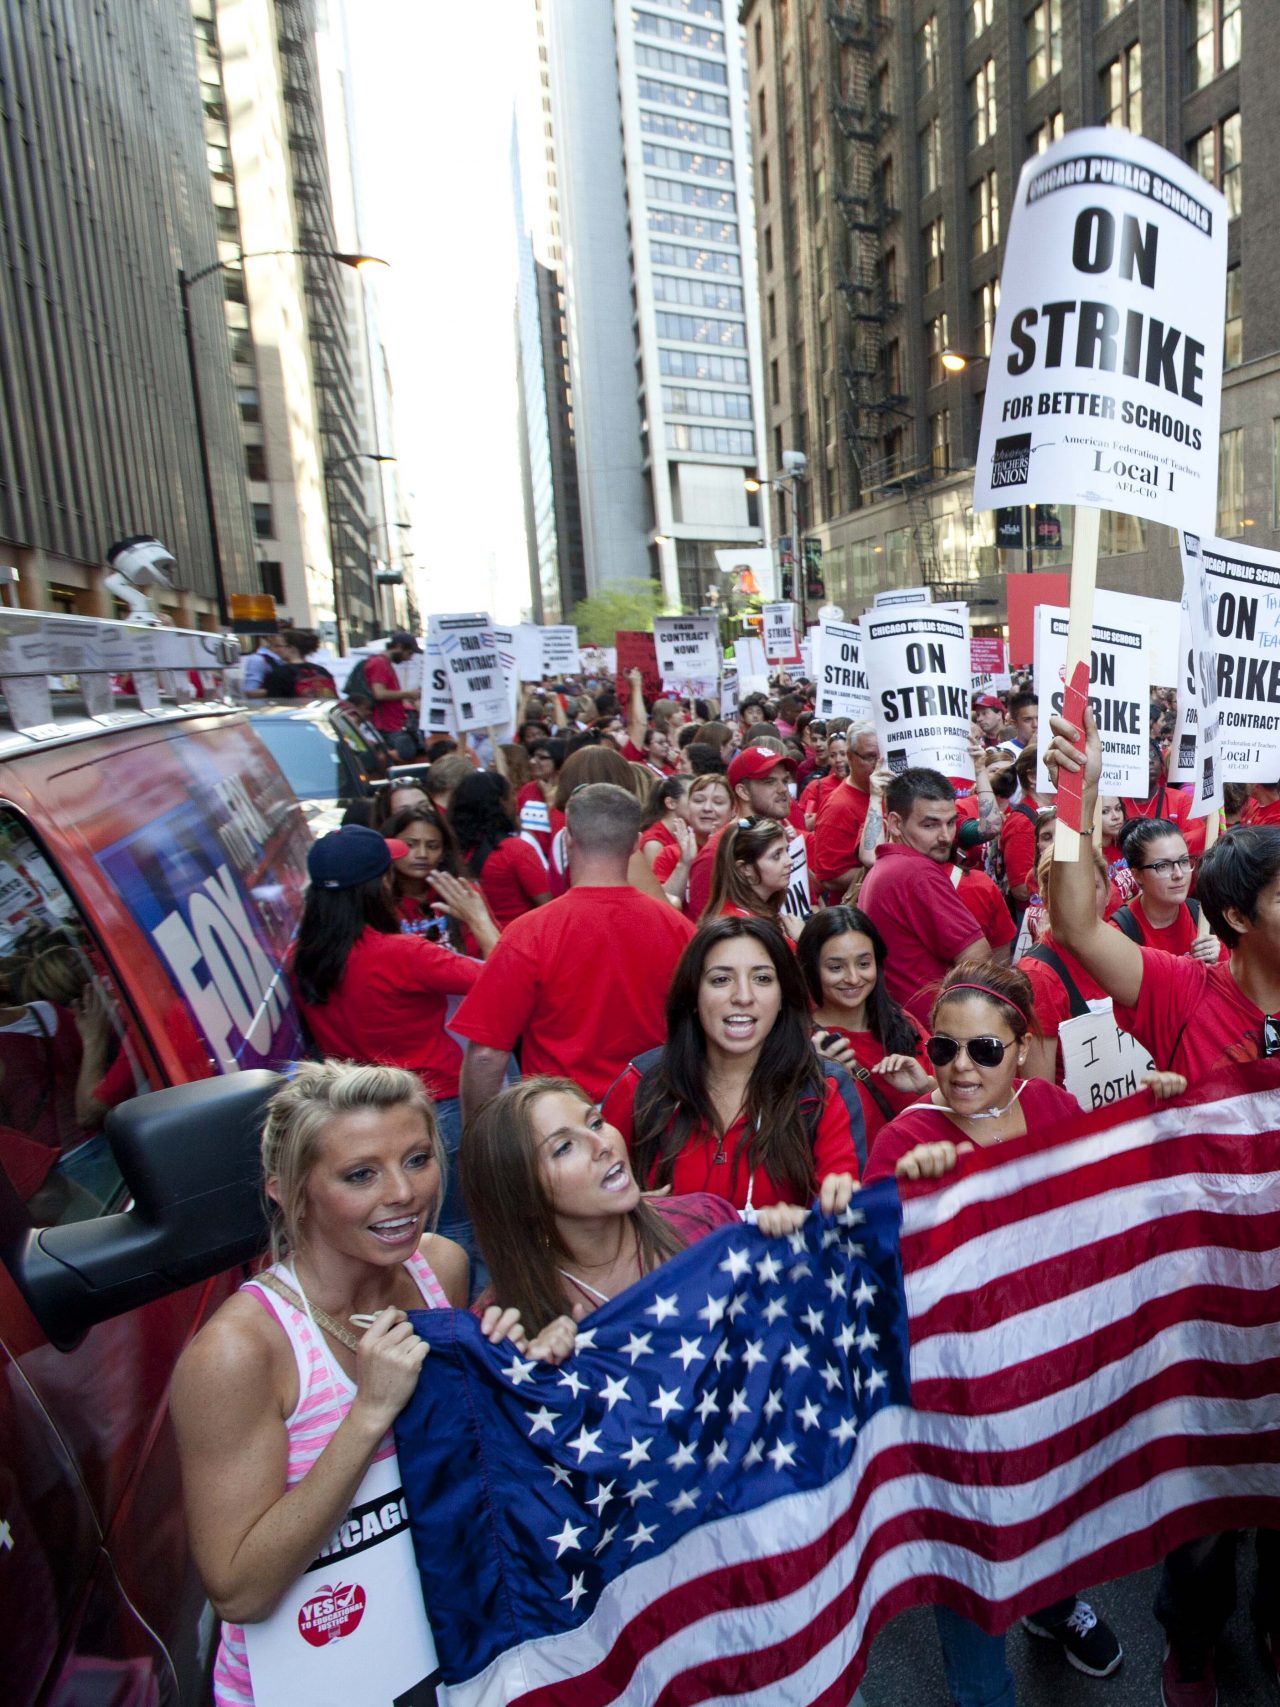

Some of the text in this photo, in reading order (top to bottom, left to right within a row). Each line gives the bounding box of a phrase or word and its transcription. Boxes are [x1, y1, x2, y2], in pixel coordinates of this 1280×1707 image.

[1029, 158, 1209, 232] CHICAGO PUBLIC SCHOOLS
[1072, 207, 1159, 290] ON
[1007, 301, 1206, 407] STRIKE
[1002, 392, 1202, 450] FOR BETTER SCHOOLS
[993, 457, 1029, 474] TEACHERS
[1062, 434, 1110, 448] American
[1113, 440, 1159, 462] Federation
[1170, 458, 1200, 479] Teachers
[992, 468, 1028, 486] UNION
[1093, 450, 1175, 492] Local 1
[1115, 481, 1157, 499] AFL-CIO
[1227, 562, 1255, 580] PUBLIC
[774, 614, 783, 625] ON
[1217, 592, 1258, 641] ON
[660, 631, 709, 643] CONTRACT
[767, 627, 791, 639] STRIKE
[871, 623, 907, 639] CHICAGO
[908, 621, 936, 633] PUBLIC
[936, 622, 964, 639] SCHOOLS
[1092, 629, 1141, 647] UBLIC SCHOOLS
[673, 644, 699, 654] NOW!
[841, 643, 858, 663] ON
[905, 642, 946, 674] ON
[450, 655, 498, 673] CONTRACT
[467, 675, 493, 691] NOW!
[824, 665, 870, 690] STRIK
[881, 685, 969, 723] STRIKE
[1050, 692, 1141, 735] SRIKE
[1227, 712, 1280, 730] CONTRACT
[887, 730, 912, 743] UNFAIR
[914, 727, 942, 738] LABOR
[936, 751, 962, 762] Local
[1100, 740, 1141, 756] CONTRACT
[1220, 747, 1250, 762] Local
[152, 863, 290, 1076] FOX
[1082, 1036, 1099, 1068] I
[1090, 1069, 1137, 1110] BOTH
[301, 1602, 363, 1631] TO EDUCATIONAL
[302, 1598, 335, 1621] YES
[318, 1615, 349, 1632] JUSTICE
